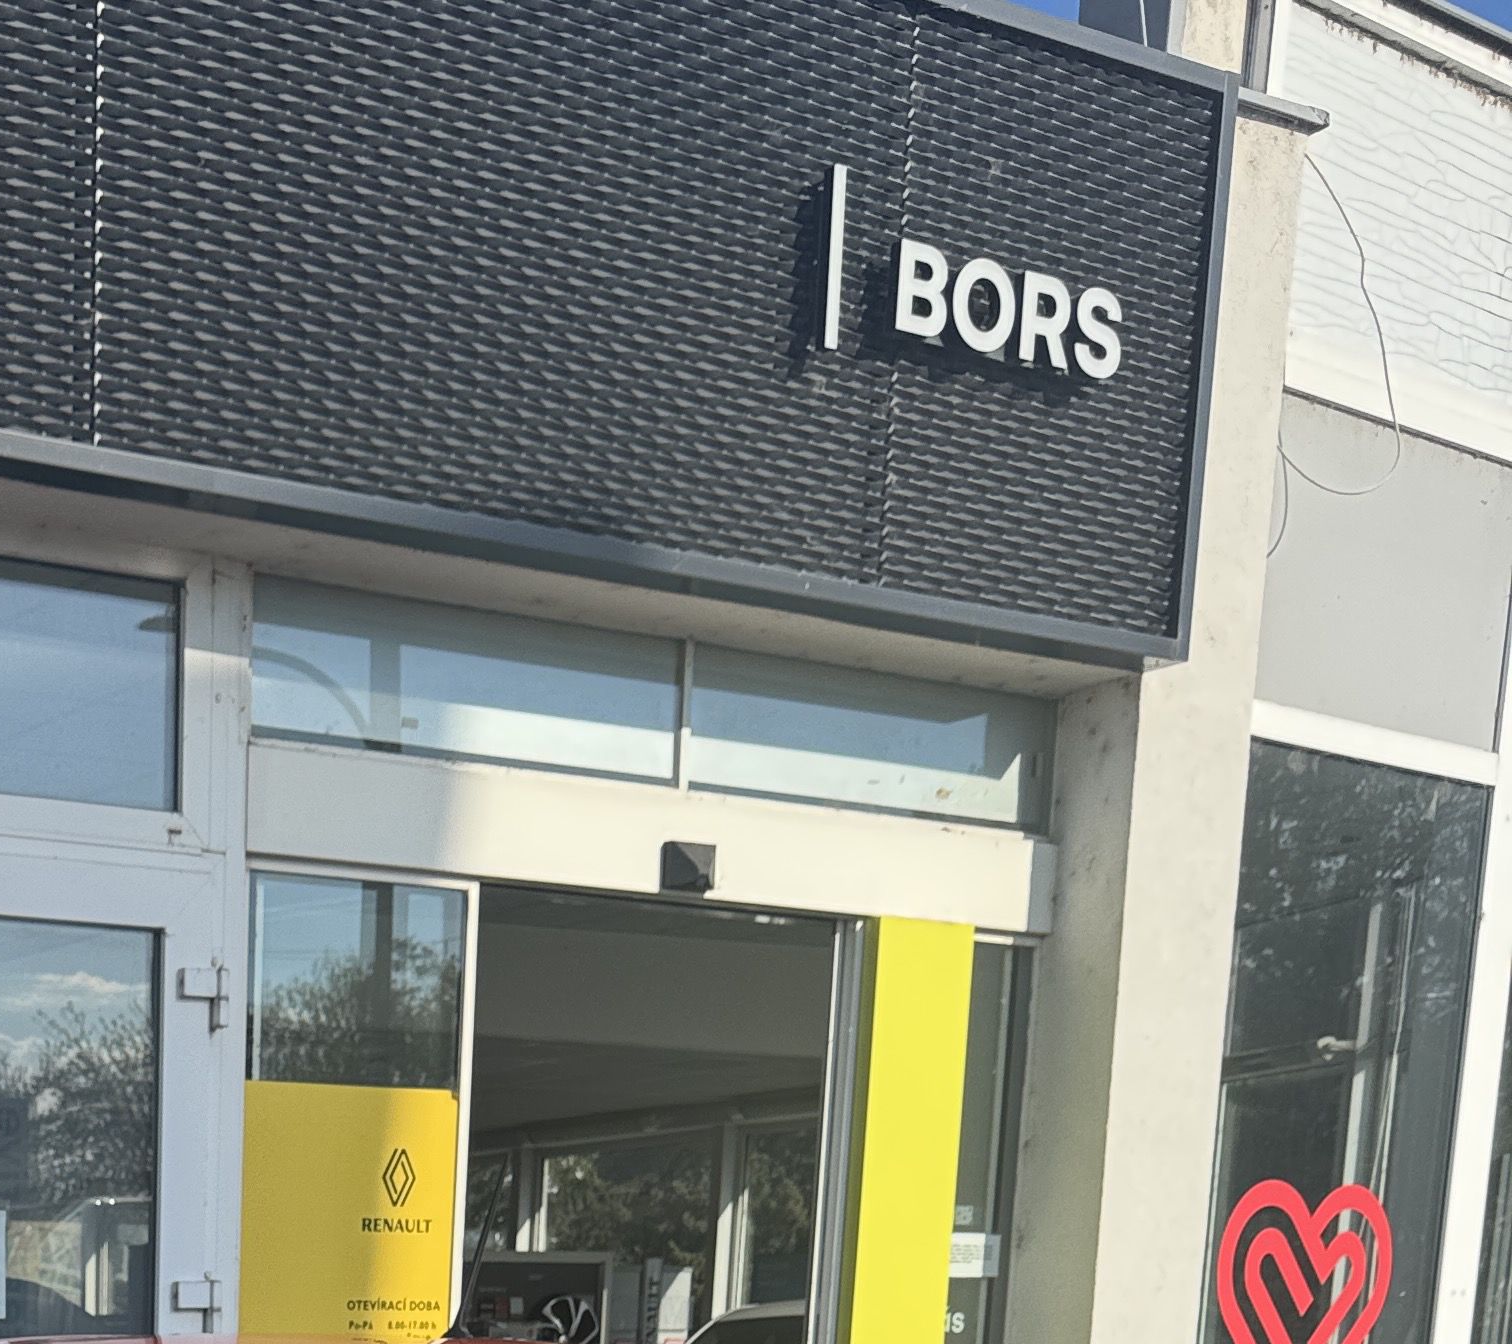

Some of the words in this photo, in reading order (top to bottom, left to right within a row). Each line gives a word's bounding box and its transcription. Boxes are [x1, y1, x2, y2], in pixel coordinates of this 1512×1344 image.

[895, 238, 1123, 379] BORS
[361, 1217, 433, 1233] RENAULT
[346, 1297, 407, 1311] OTEVÍRACÍ
[409, 1301, 441, 1311] DOBA
